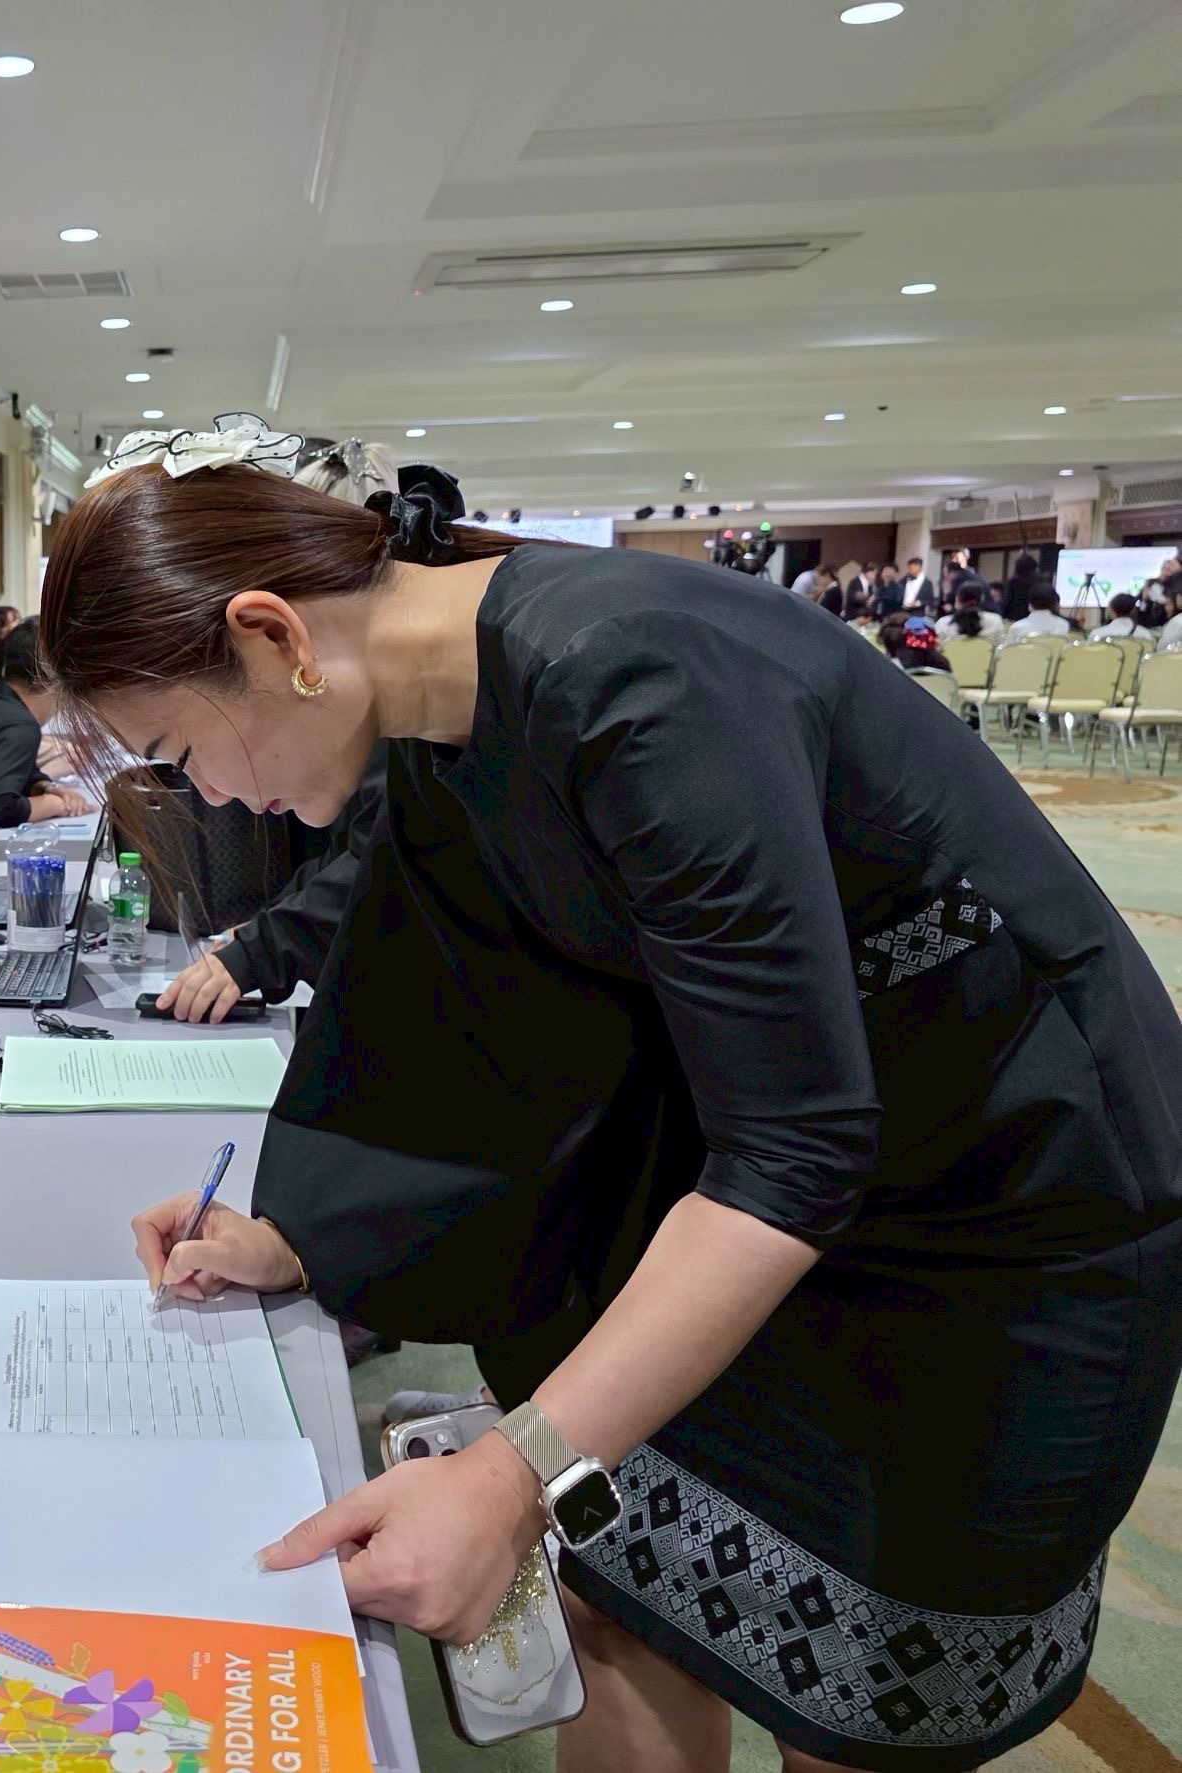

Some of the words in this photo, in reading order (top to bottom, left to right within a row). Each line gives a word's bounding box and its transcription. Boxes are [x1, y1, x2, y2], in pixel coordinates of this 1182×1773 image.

[267, 1649, 296, 1689] ALL
[311, 1661, 322, 1687] WOOD
[270, 1694, 300, 1742] FOR
